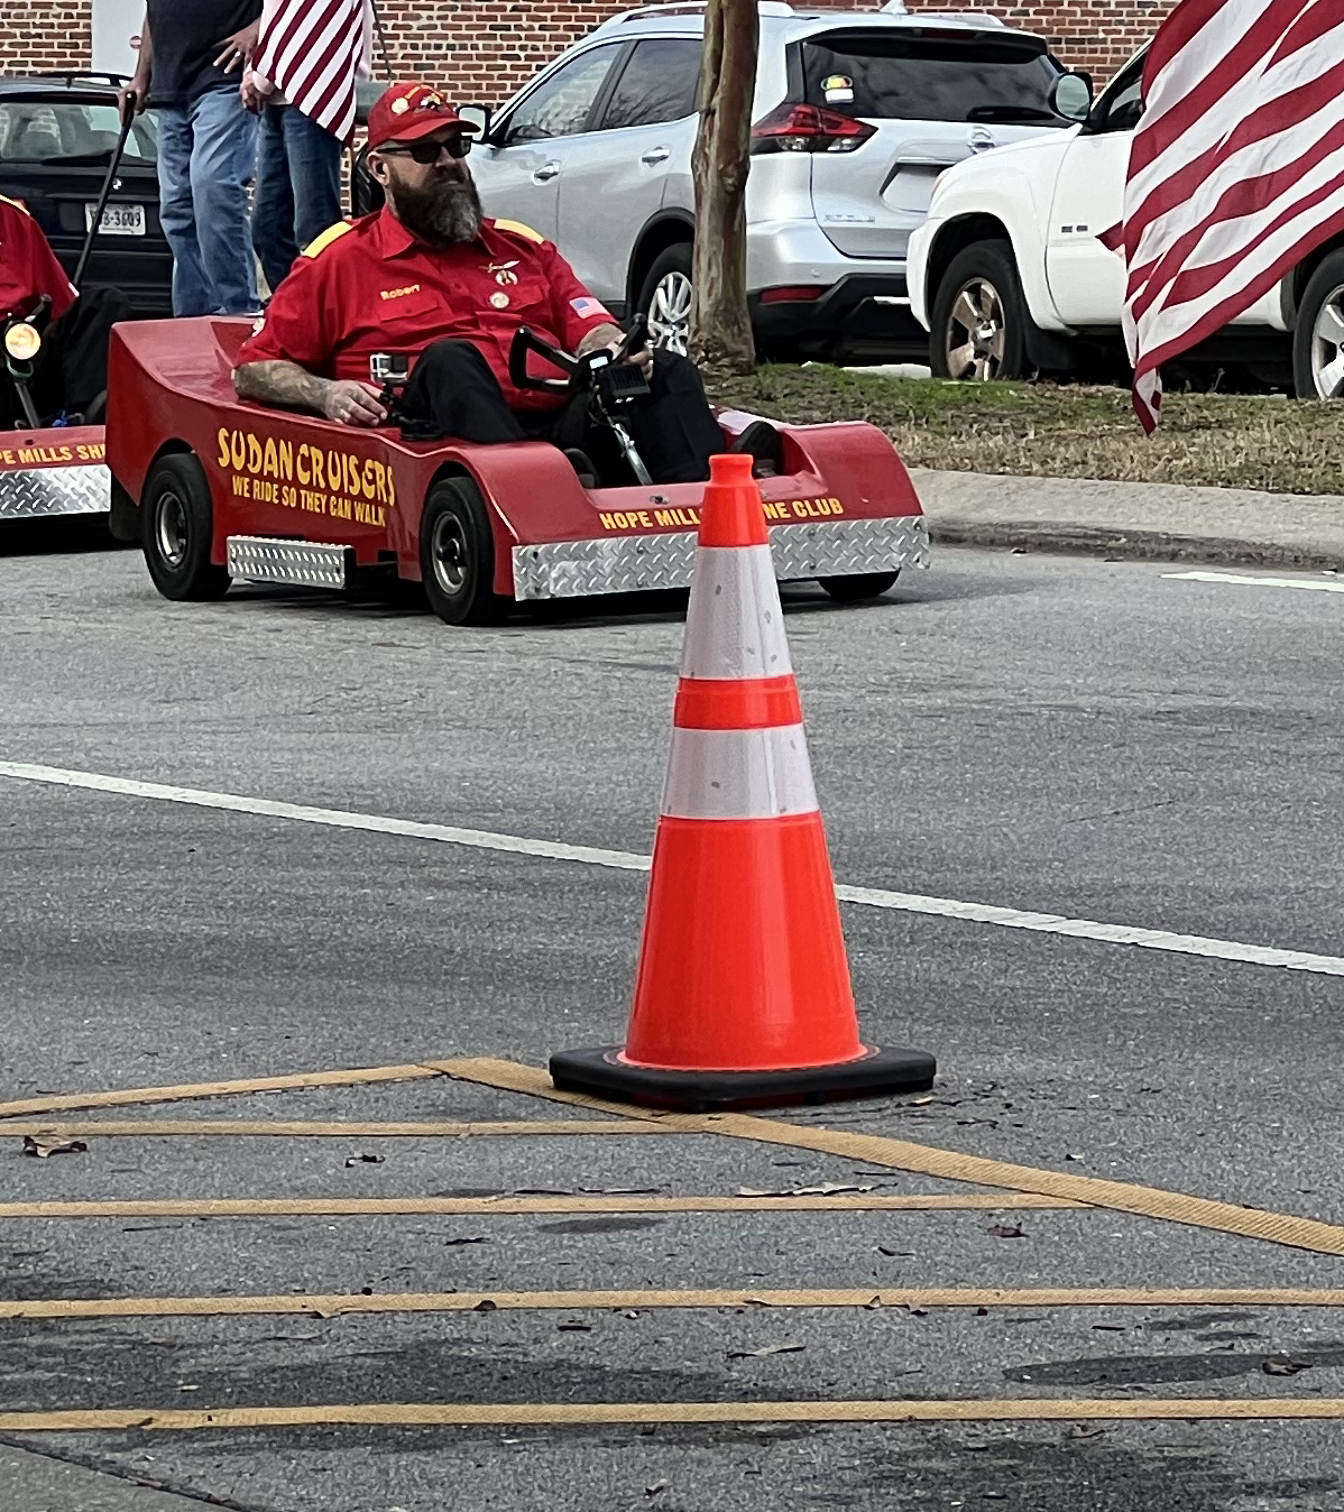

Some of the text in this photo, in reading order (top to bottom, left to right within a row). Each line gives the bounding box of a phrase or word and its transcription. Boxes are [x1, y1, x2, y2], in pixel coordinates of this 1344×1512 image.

[379, 285, 421, 301] Robert
[18, 447, 73, 463] MILLS
[218, 427, 395, 507] SUDAN CRUISERS
[232, 475, 386, 527] WE RIDE SO THEY CAN WALK
[599, 510, 653, 529] HOPE
[656, 508, 702, 526] MILL
[792, 498, 844, 517] CLUB
